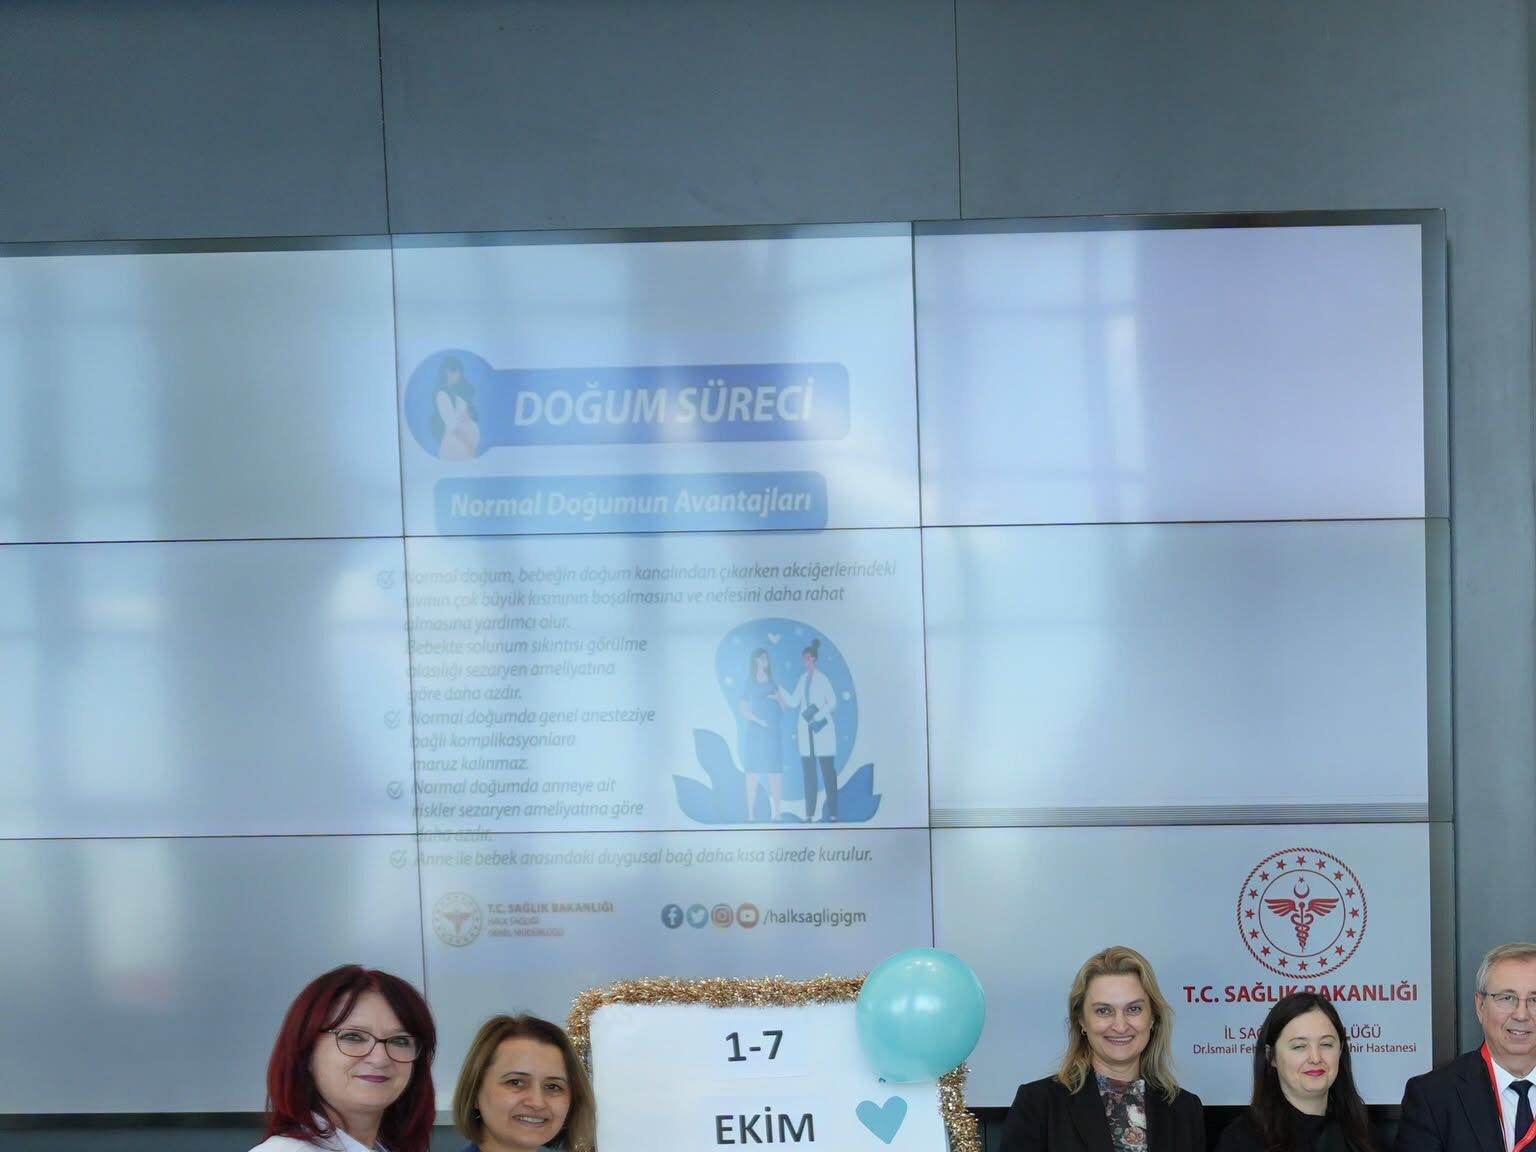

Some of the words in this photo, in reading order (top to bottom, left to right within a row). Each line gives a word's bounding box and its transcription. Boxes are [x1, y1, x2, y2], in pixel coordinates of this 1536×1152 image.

[514, 382, 667, 426] DOĞUM
[674, 377, 815, 423] SÜRECİ
[450, 491, 541, 518] Normal
[547, 492, 667, 521] Doğumun
[674, 485, 811, 518] Avantajları
[763, 909, 866, 926] /halksagligigm
[1183, 986, 1219, 1003] T.C.
[1225, 1025, 1235, 1039] İL
[725, 1030, 784, 1062] 1-7
[1193, 1043, 1237, 1054] Dr.İsmail
[1367, 1043, 1417, 1053] Hastanesi
[715, 1106, 815, 1145] EKİM
